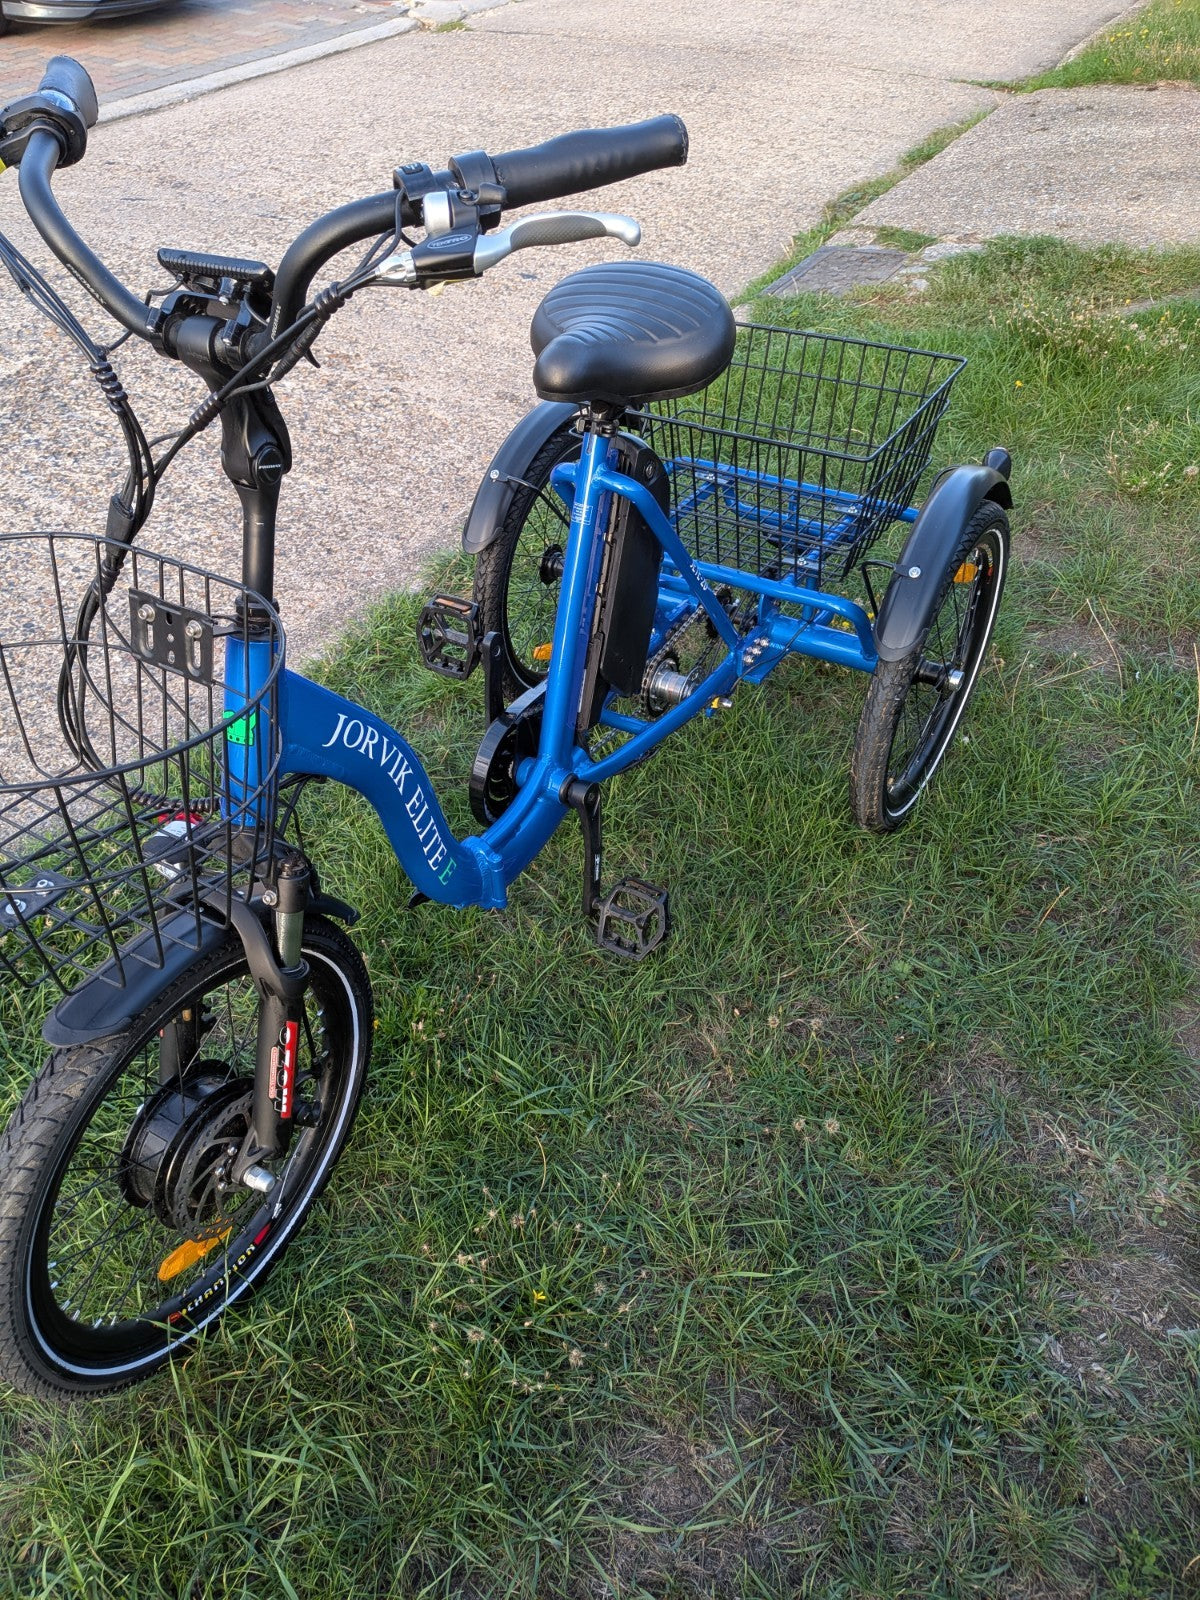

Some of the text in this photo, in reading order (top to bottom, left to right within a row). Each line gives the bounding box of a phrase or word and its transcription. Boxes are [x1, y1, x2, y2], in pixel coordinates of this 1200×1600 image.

[322, 713, 413, 796] JORVIK
[404, 784, 448, 871] ELITE
[273, 1026, 291, 1113] MOZO
